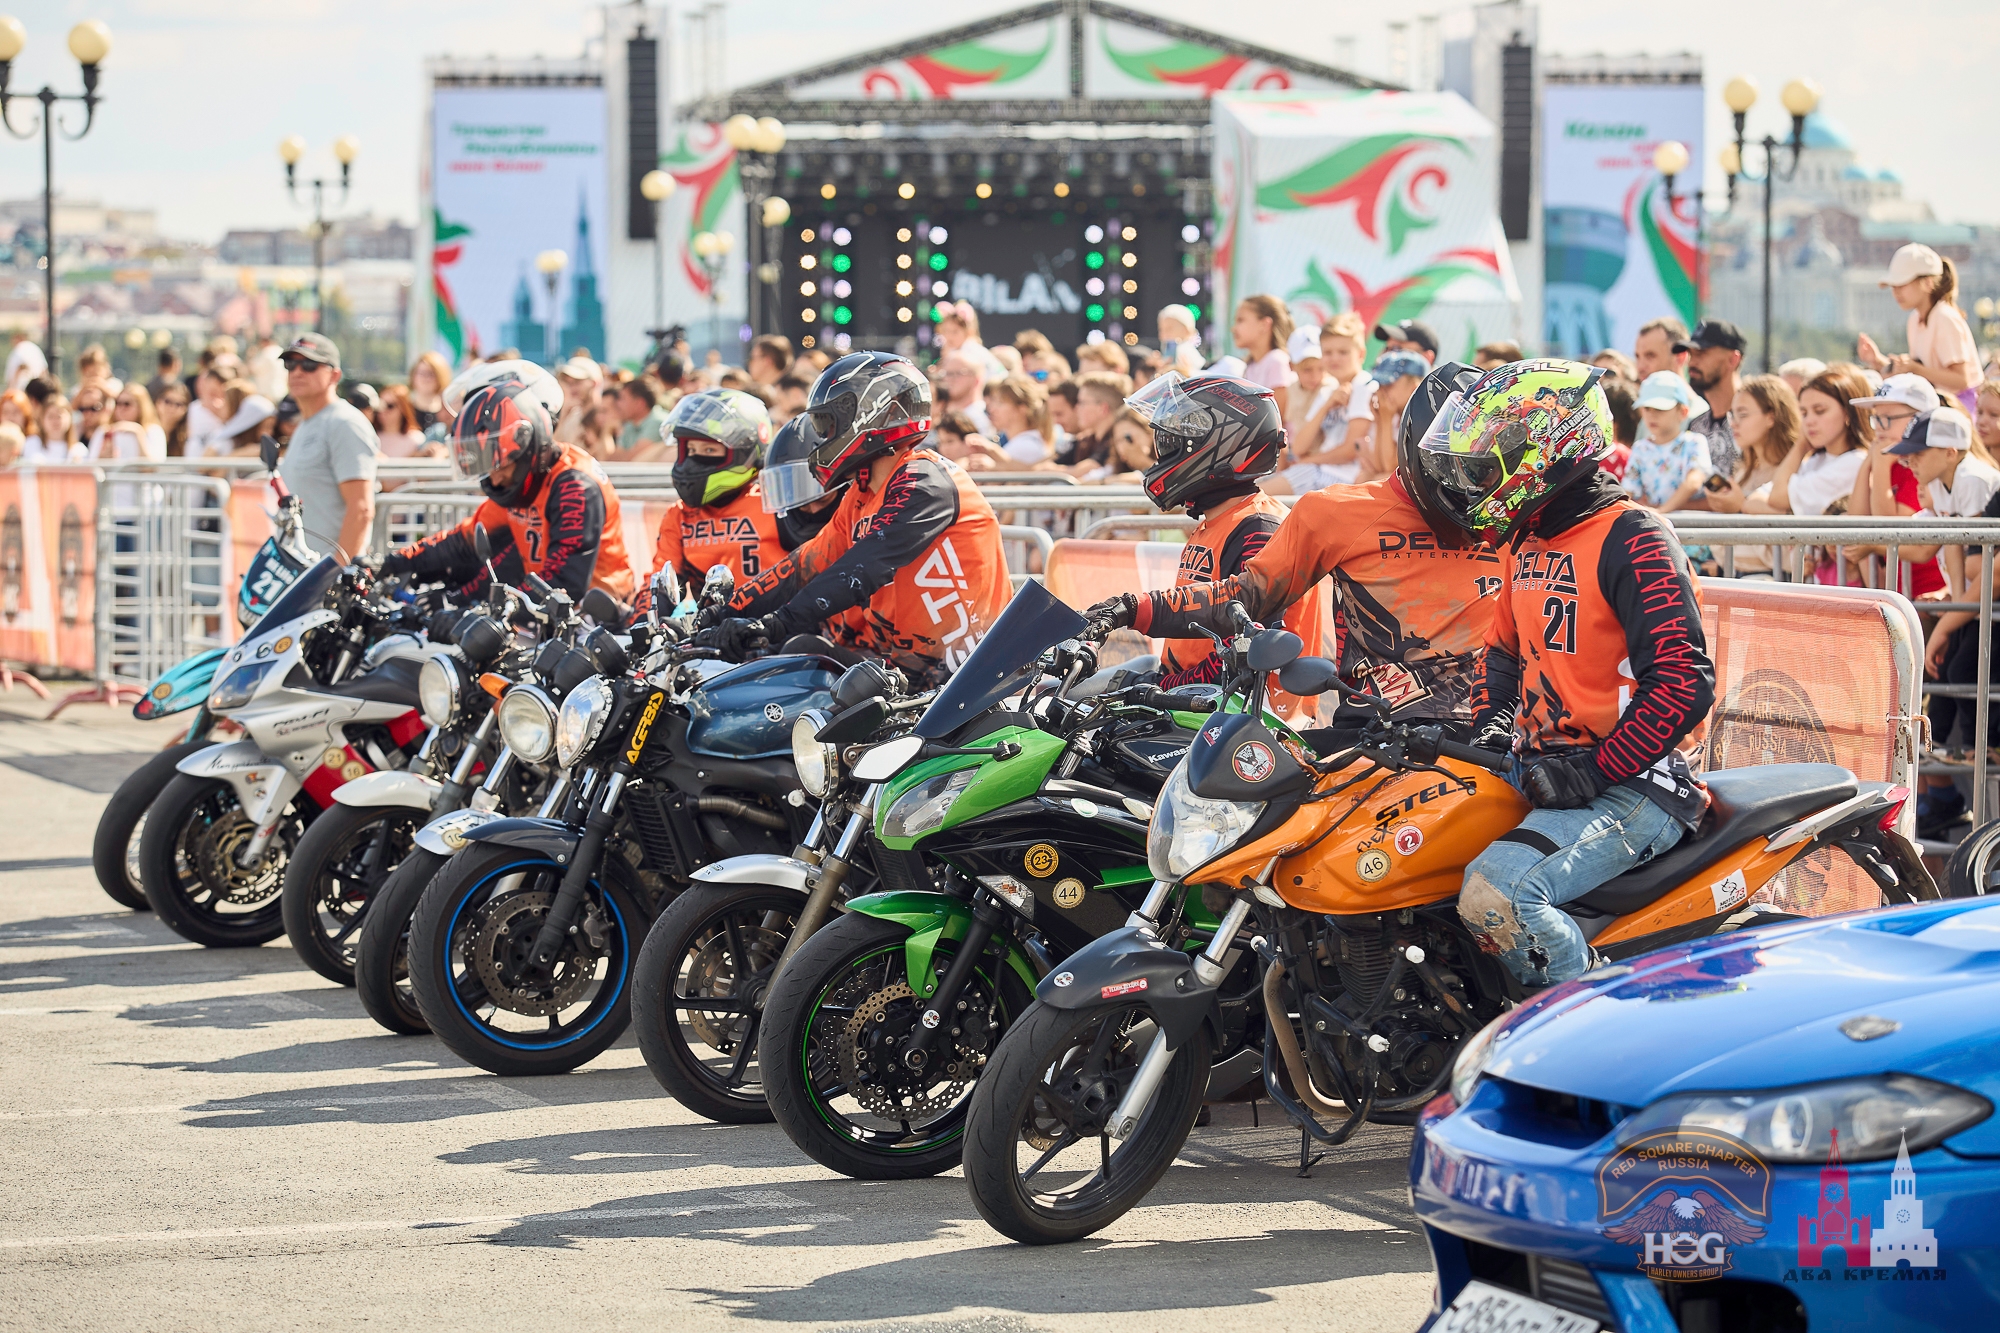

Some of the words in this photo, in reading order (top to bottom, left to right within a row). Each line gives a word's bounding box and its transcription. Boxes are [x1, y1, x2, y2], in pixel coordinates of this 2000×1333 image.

[852, 389, 892, 434] HJC
[1207, 386, 1258, 415] NOLAN
[559, 479, 586, 532] KAZAN
[682, 517, 758, 541] DELTA
[740, 543, 761, 578] 5
[1381, 552, 1461, 560] BATTERY
[1512, 551, 1577, 584] DELTA
[251, 570, 285, 602] 21
[1625, 530, 1685, 615] KAZAN
[914, 537, 977, 674] ELTA
[1543, 595, 1578, 654] 21
[328, 754, 342, 763] 21
[1148, 746, 1191, 763] Kawasa
[1749, 731, 1787, 758] RUSSIA
[1375, 776, 1478, 825] STELS
[1404, 835, 1416, 849] 2
[1034, 855, 1049, 866] 23
[1364, 857, 1384, 875] 46
[1058, 886, 1078, 900] 44
